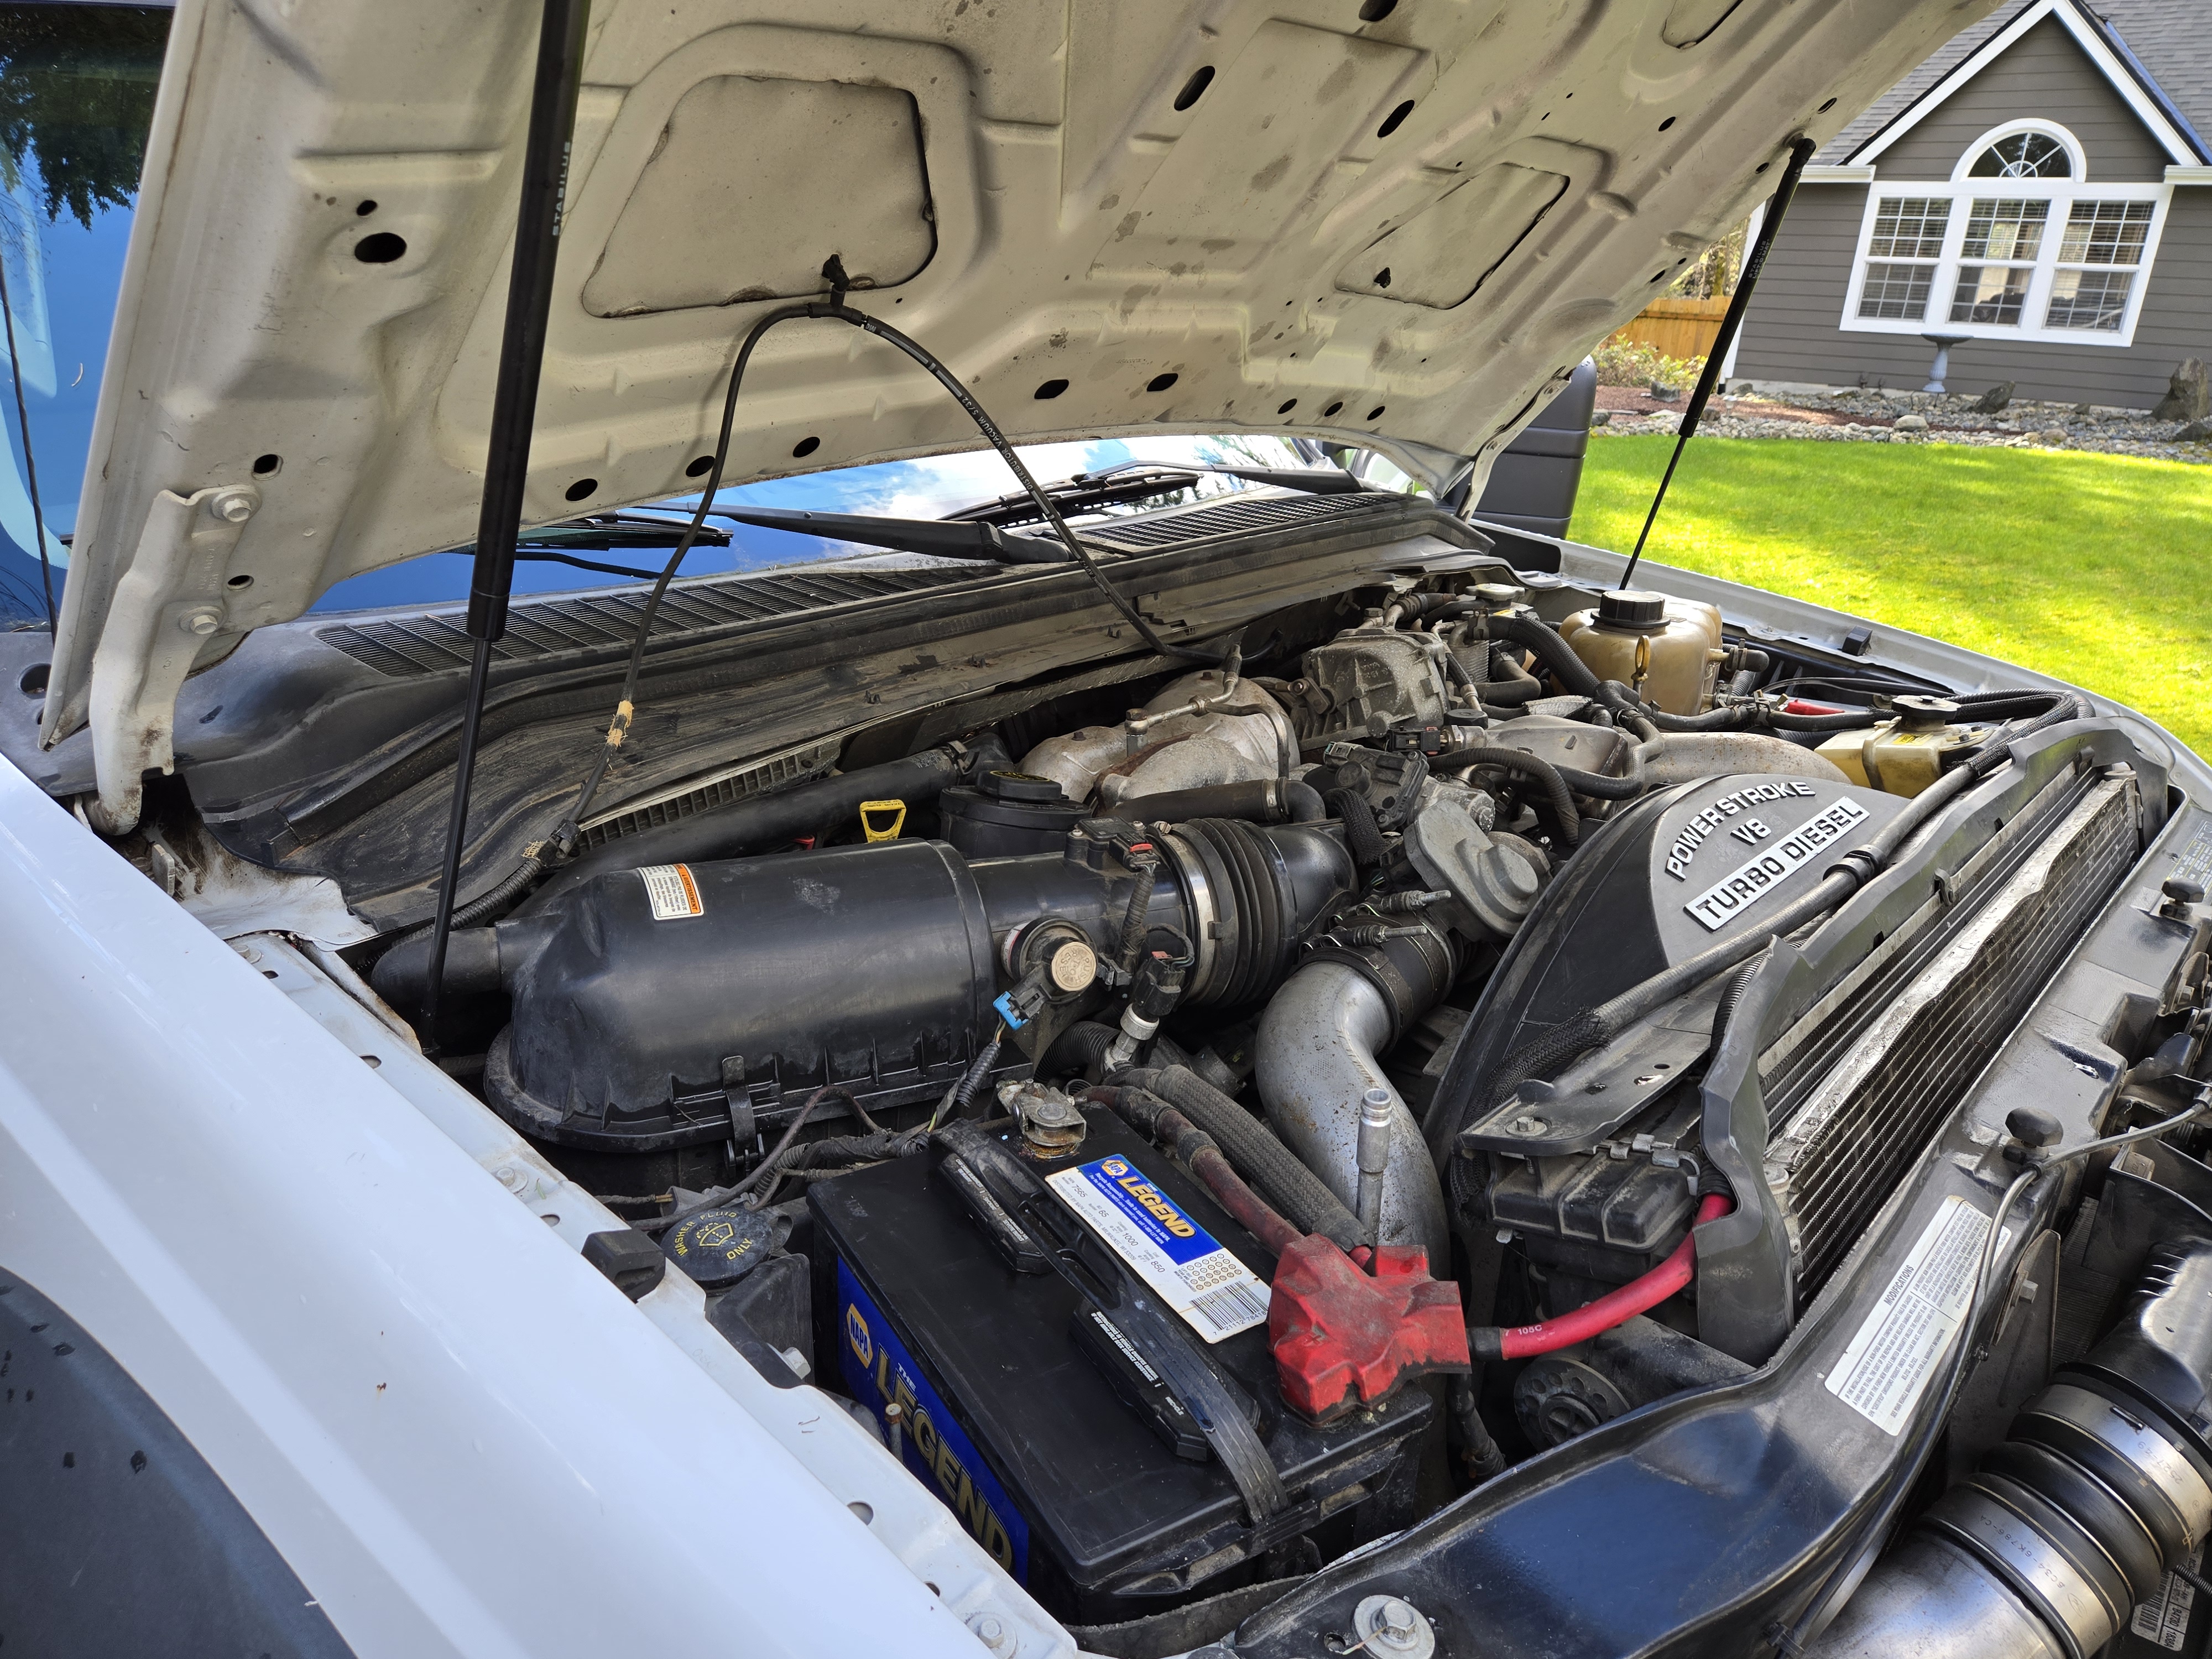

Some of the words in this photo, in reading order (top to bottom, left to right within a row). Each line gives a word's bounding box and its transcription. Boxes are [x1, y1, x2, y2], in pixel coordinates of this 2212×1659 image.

[552, 141, 570, 236] STABILUS
[962, 397, 978, 415] 5/32
[978, 416, 1002, 447] VACUUM
[1001, 448, 1034, 490] DISTRIBUTOR
[1730, 818, 1771, 846] V8
[1695, 857, 1786, 919] TURBO
[1780, 806, 1863, 862] DIESEL
[1070, 1184, 1088, 1198] 7565
[1097, 1209, 1109, 1218] 65
[1116, 1176, 1196, 1238] LEGEND
[675, 1221, 695, 1256] WASHER
[700, 1212, 737, 1220] FLUID
[1121, 1232, 1139, 1246] 1000
[726, 1238, 752, 1260] ONLY
[1150, 1260, 1166, 1274] 850
[1882, 1264, 1914, 1306] MODIFICATIONS
[1224, 1320, 1245, 1331] 21112
[1246, 1311, 1266, 1322] 78418
[1517, 1325, 1542, 1335] 105C
[850, 1313, 869, 1359] NAPA
[898, 1363, 916, 1391] THE
[1165, 1396, 1183, 1415] RECYCLE
[875, 1343, 1012, 1573] LEGEND
[2137, 1442, 2183, 1484] 2527-49
[2164, 1629, 2177, 1648] 1838A
